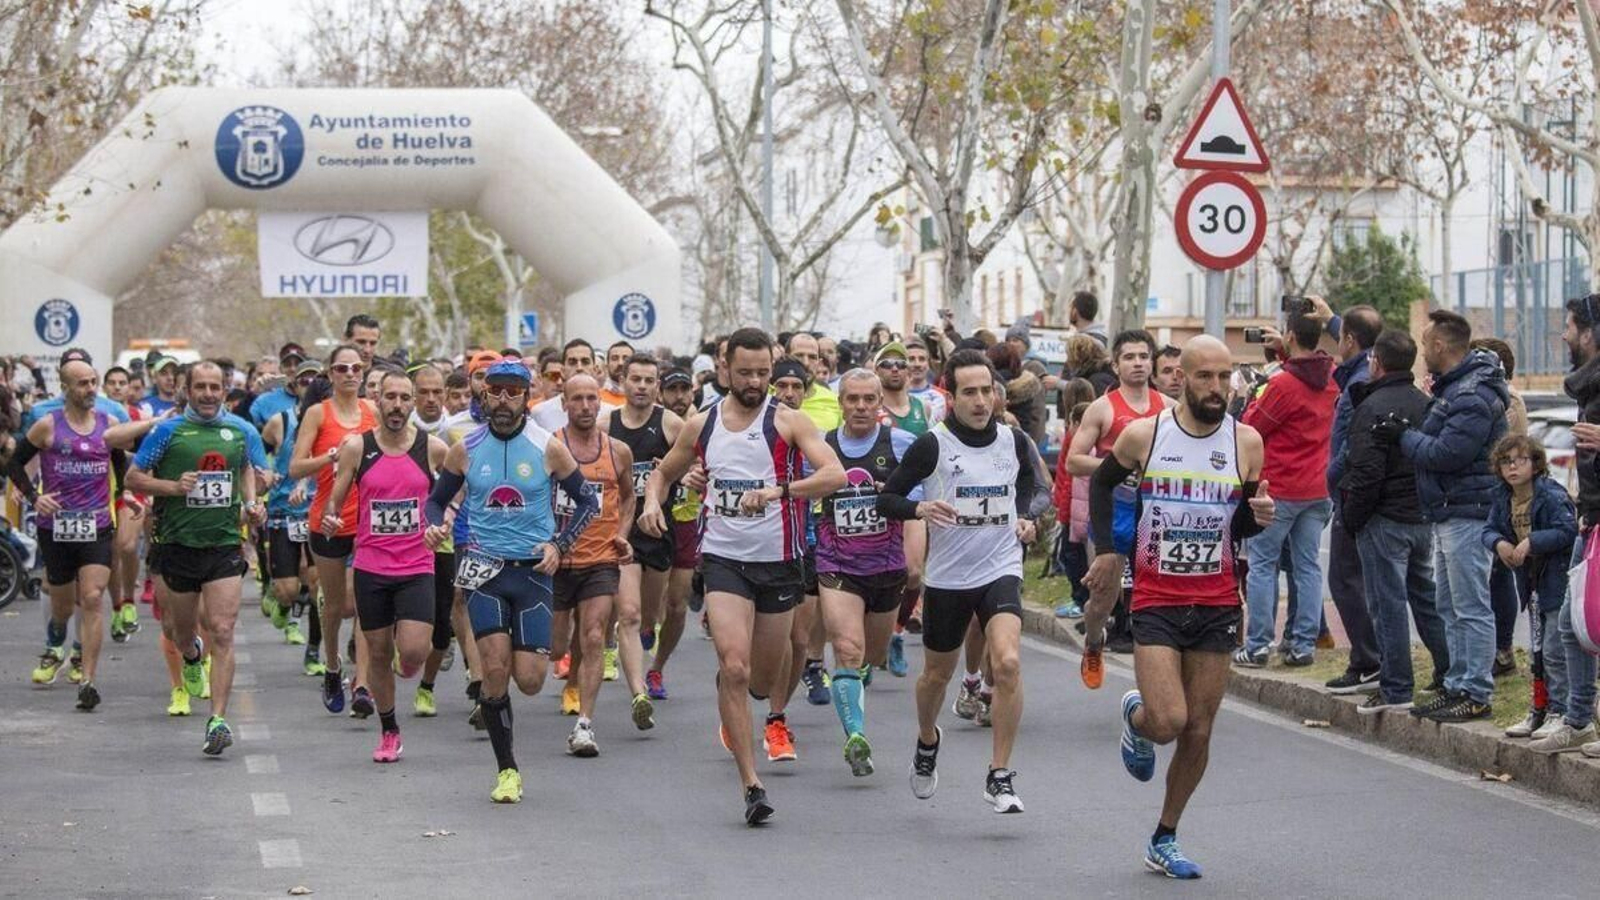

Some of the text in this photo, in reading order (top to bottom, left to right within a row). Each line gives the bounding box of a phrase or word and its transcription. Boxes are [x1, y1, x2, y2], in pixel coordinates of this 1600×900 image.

[310, 113, 472, 132] Ayuntamiento
[356, 132, 473, 150] de Huelva
[393, 155, 410, 166] de
[414, 155, 475, 167] Deportes
[1199, 204, 1246, 234] 30
[279, 275, 408, 294] HYUNDAI
[200, 483, 223, 497] 13
[978, 498, 989, 515] 1
[377, 510, 412, 525] 141
[842, 508, 881, 526] 149
[60, 520, 90, 533] 115
[1168, 543, 1217, 562] 437
[462, 561, 493, 580] 154
